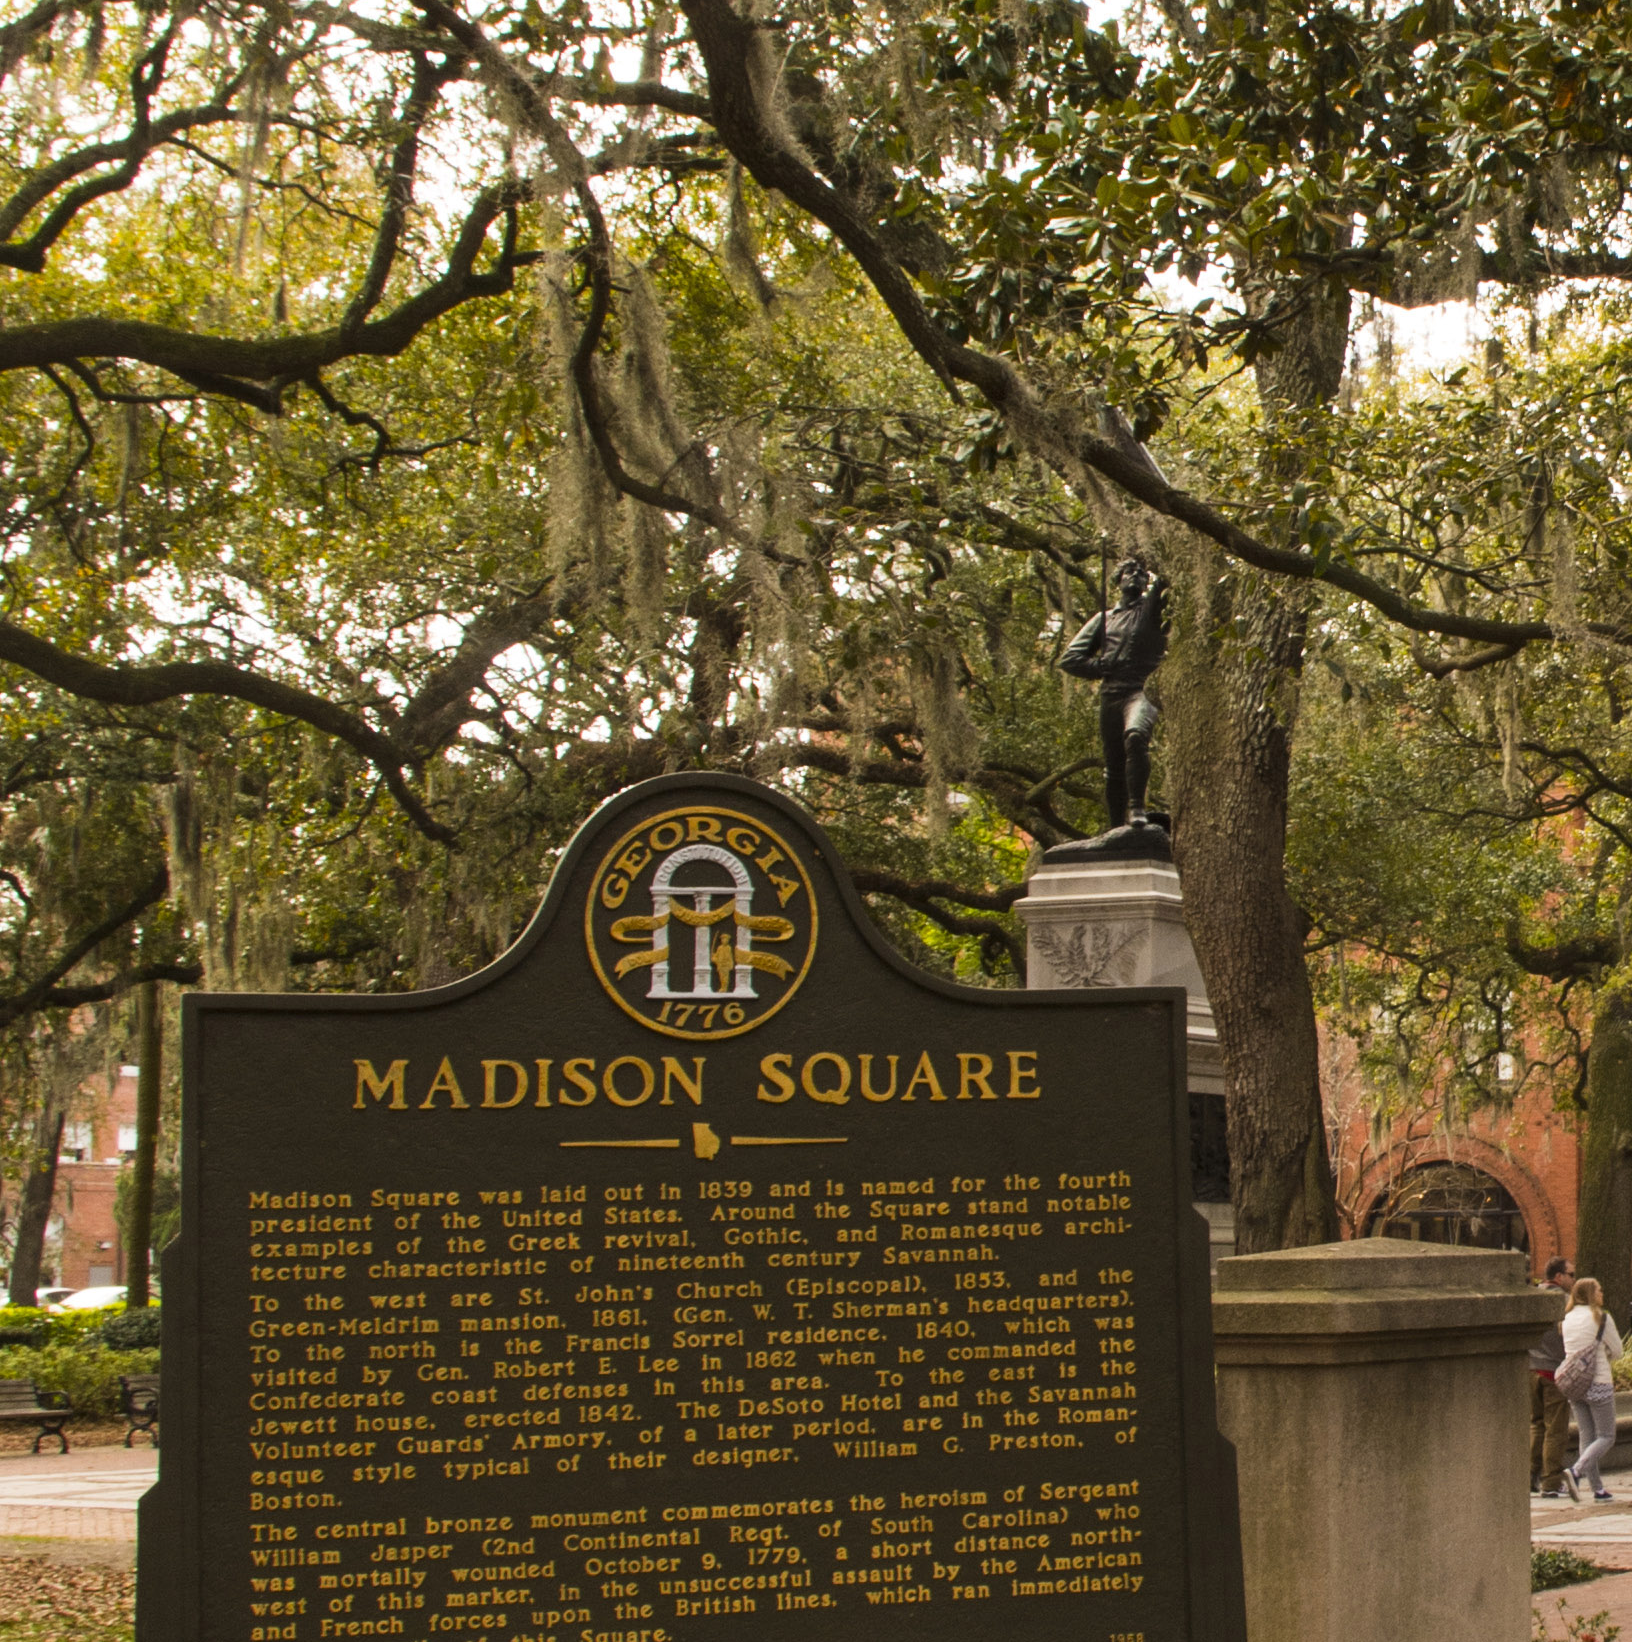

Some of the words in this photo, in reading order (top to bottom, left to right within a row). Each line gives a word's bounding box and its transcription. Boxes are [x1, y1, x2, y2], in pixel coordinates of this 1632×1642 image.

[601, 816, 800, 909] GEORGIA
[656, 1001, 746, 1029] 1776
[352, 1055, 707, 1110] MADISON
[757, 1050, 1042, 1107] SQUARE
[247, 1190, 352, 1211] Madison
[369, 1187, 461, 1212] Square
[476, 1189, 524, 1206] was
[539, 1184, 587, 1204] laid
[602, 1183, 644, 1202] out
[658, 1181, 682, 1201] in
[698, 1179, 753, 1200] 1839
[768, 1179, 811, 1198] and
[824, 1179, 845, 1197] is
[860, 1176, 935, 1197] named
[949, 1174, 987, 1194] for
[1002, 1172, 1041, 1192] the
[1057, 1169, 1132, 1190] fourth
[248, 1214, 372, 1238] president
[392, 1212, 421, 1231] of
[440, 1210, 481, 1230] the
[501, 1207, 583, 1229] United
[603, 1205, 684, 1226] States.
[709, 1202, 796, 1222] Around
[812, 1201, 851, 1220] the
[868, 1199, 951, 1222] Square
[966, 1196, 1029, 1216] stand
[1046, 1193, 1132, 1214] notable
[248, 1238, 373, 1260] examples
[395, 1236, 422, 1256] of
[444, 1235, 487, 1255] the
[506, 1231, 581, 1252] Greek
[835, 1224, 878, 1244] and
[899, 1221, 1044, 1241] Romanesque
[1063, 1216, 1133, 1236] archi-
[249, 1264, 346, 1283] tecture
[366, 1257, 547, 1280] characteristic
[568, 1254, 595, 1275] of
[616, 1251, 745, 1273] nineteenth
[765, 1249, 861, 1269] century
[881, 1243, 1000, 1266] Savannah.
[247, 1293, 280, 1314] To
[302, 1292, 344, 1312] the
[367, 1291, 427, 1310] west
[449, 1291, 494, 1309] are
[516, 1286, 550, 1307] St.
[574, 1283, 654, 1304] John's
[675, 1279, 763, 1301] Church
[1037, 1268, 1078, 1288] and
[1097, 1267, 1135, 1285] the
[247, 1389, 405, 1412] Confederate
[429, 1386, 497, 1406] coast
[521, 1382, 629, 1402] defenses
[652, 1377, 676, 1397] in
[700, 1375, 745, 1395] this
[768, 1374, 830, 1392] area.
[873, 1369, 905, 1388] To
[927, 1366, 965, 1386] the
[987, 1364, 1036, 1383] east
[1058, 1361, 1078, 1379] is
[1099, 1358, 1137, 1377] the
[248, 1366, 337, 1388] visited
[361, 1364, 393, 1387] by
[415, 1363, 469, 1383] Gen.
[492, 1359, 575, 1380] Robert
[597, 1355, 617, 1376] E.
[637, 1354, 680, 1374] Lee
[700, 1353, 723, 1372] in
[745, 1349, 797, 1370] 1862
[816, 1348, 876, 1367] when
[896, 1345, 926, 1365] he
[945, 1338, 1077, 1362] commanded
[1098, 1336, 1136, 1355] the
[674, 1400, 721, 1421] The
[737, 1396, 825, 1418] DeSoto
[839, 1392, 902, 1413] Hotel
[917, 1389, 959, 1410] and
[975, 1387, 1013, 1407] the
[1026, 1381, 1137, 1405] Savannah
[248, 1468, 325, 1489] esque
[351, 1461, 417, 1485] style
[442, 1456, 530, 1482] typical
[554, 1453, 581, 1474] of
[606, 1450, 668, 1471] their
[832, 1439, 918, 1459] William
[940, 1435, 964, 1455] G.
[248, 1523, 298, 1544] The
[313, 1516, 407, 1541] central
[423, 1515, 514, 1536] bronze
[528, 1505, 648, 1530] monument
[660, 1497, 834, 1523] commemorates
[847, 1493, 886, 1513] the
[899, 1488, 988, 1510] heroism
[1001, 1484, 1026, 1505] of
[1038, 1478, 1140, 1504] Sergeant
[248, 1548, 342, 1568] William
[368, 1543, 454, 1563] Jasper
[480, 1536, 535, 1557] (2nd
[561, 1526, 701, 1553] Continental
[728, 1524, 790, 1548] Regt.
[816, 1518, 843, 1539] of
[869, 1515, 935, 1536] South
[960, 1506, 1069, 1531] Carolina)
[1094, 1504, 1141, 1521] who
[249, 1597, 307, 1617] west
[327, 1593, 354, 1614] of
[375, 1591, 425, 1612] this
[558, 1582, 581, 1603] in
[599, 1580, 639, 1599] the
[657, 1568, 812, 1596] unsuccessful
[830, 1563, 913, 1587] assault
[931, 1560, 961, 1583] by
[979, 1558, 1018, 1577] the
[1035, 1551, 1143, 1573] American
[249, 1621, 297, 1642] and
[319, 1615, 405, 1638] French
[427, 1612, 508, 1633] forces
[530, 1607, 591, 1629] upon
[613, 1601, 654, 1621] the
[674, 1594, 757, 1618] British
[864, 1583, 932, 1606] which
[950, 1584, 991, 1601] ran
[1010, 1572, 1145, 1598] immediately
